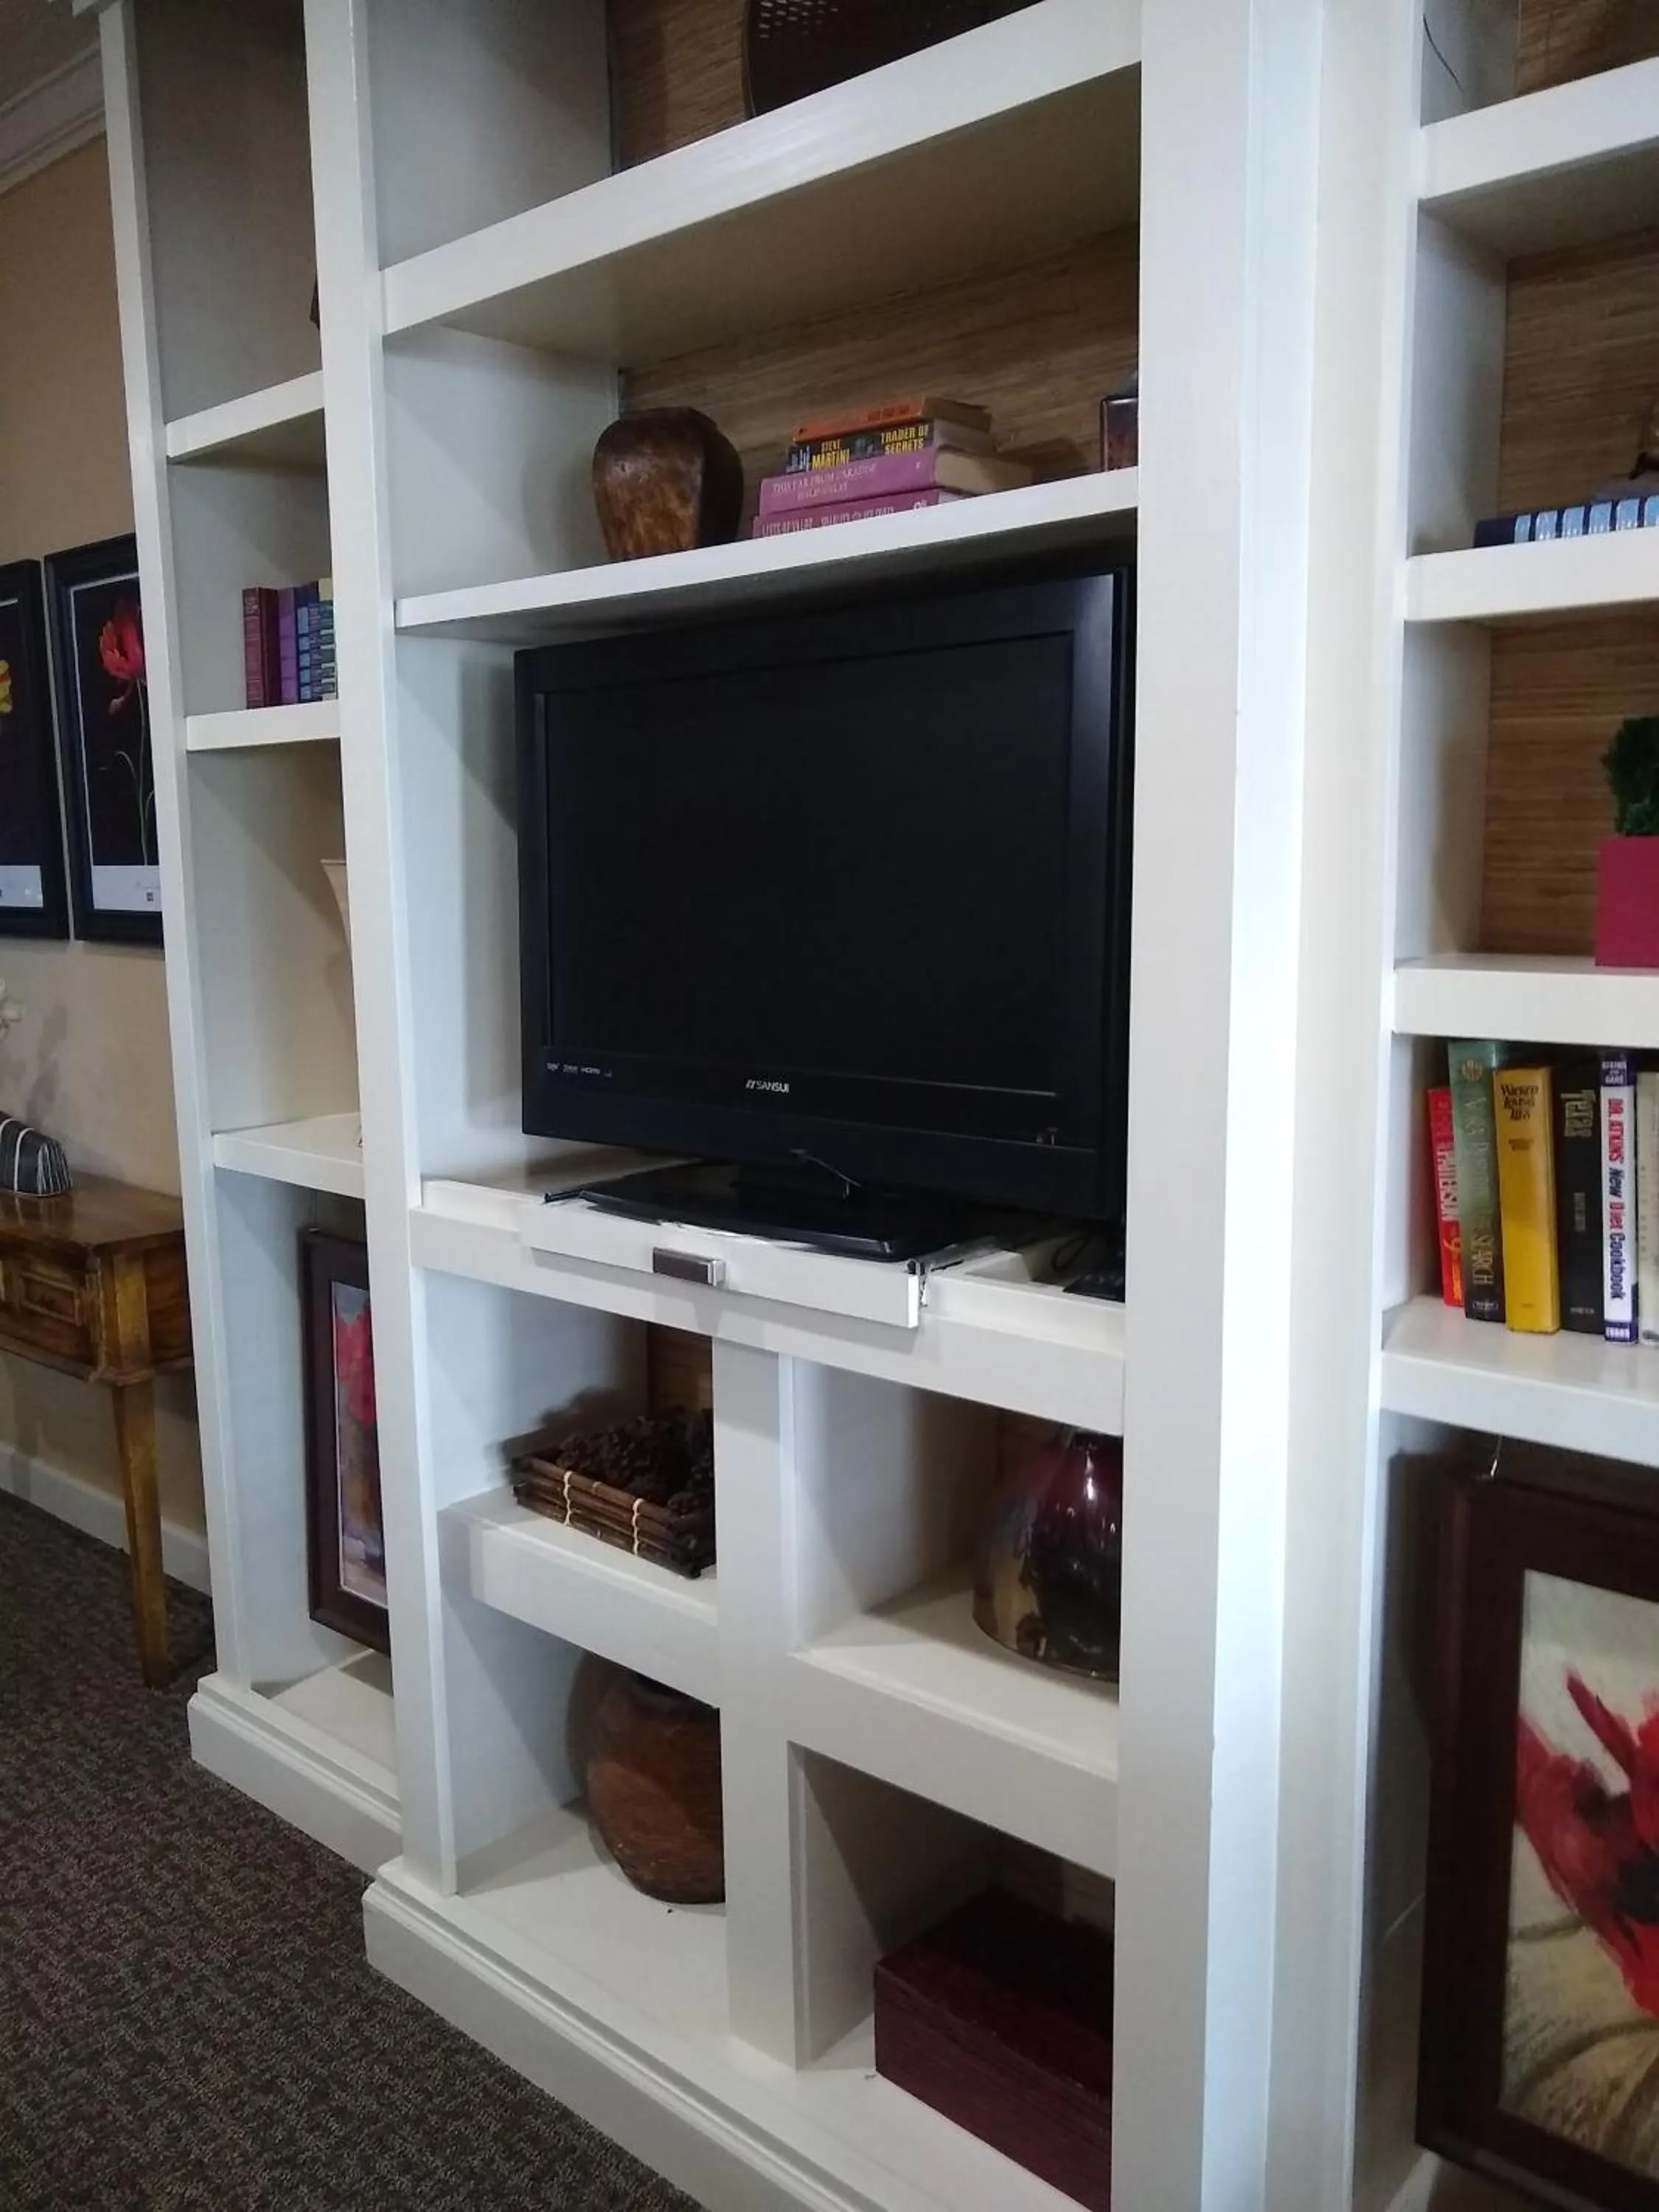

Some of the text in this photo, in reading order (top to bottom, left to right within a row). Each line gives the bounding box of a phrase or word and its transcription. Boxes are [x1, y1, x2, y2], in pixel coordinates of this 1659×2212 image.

[880, 426, 916, 444] TRADER
[885, 438, 925, 456] SECRETS
[812, 448, 851, 470] MARTINI
[1609, 1166, 1624, 1198] New
[1609, 1202, 1625, 1230] Diet
[1610, 1232, 1626, 1300] Cookbook
